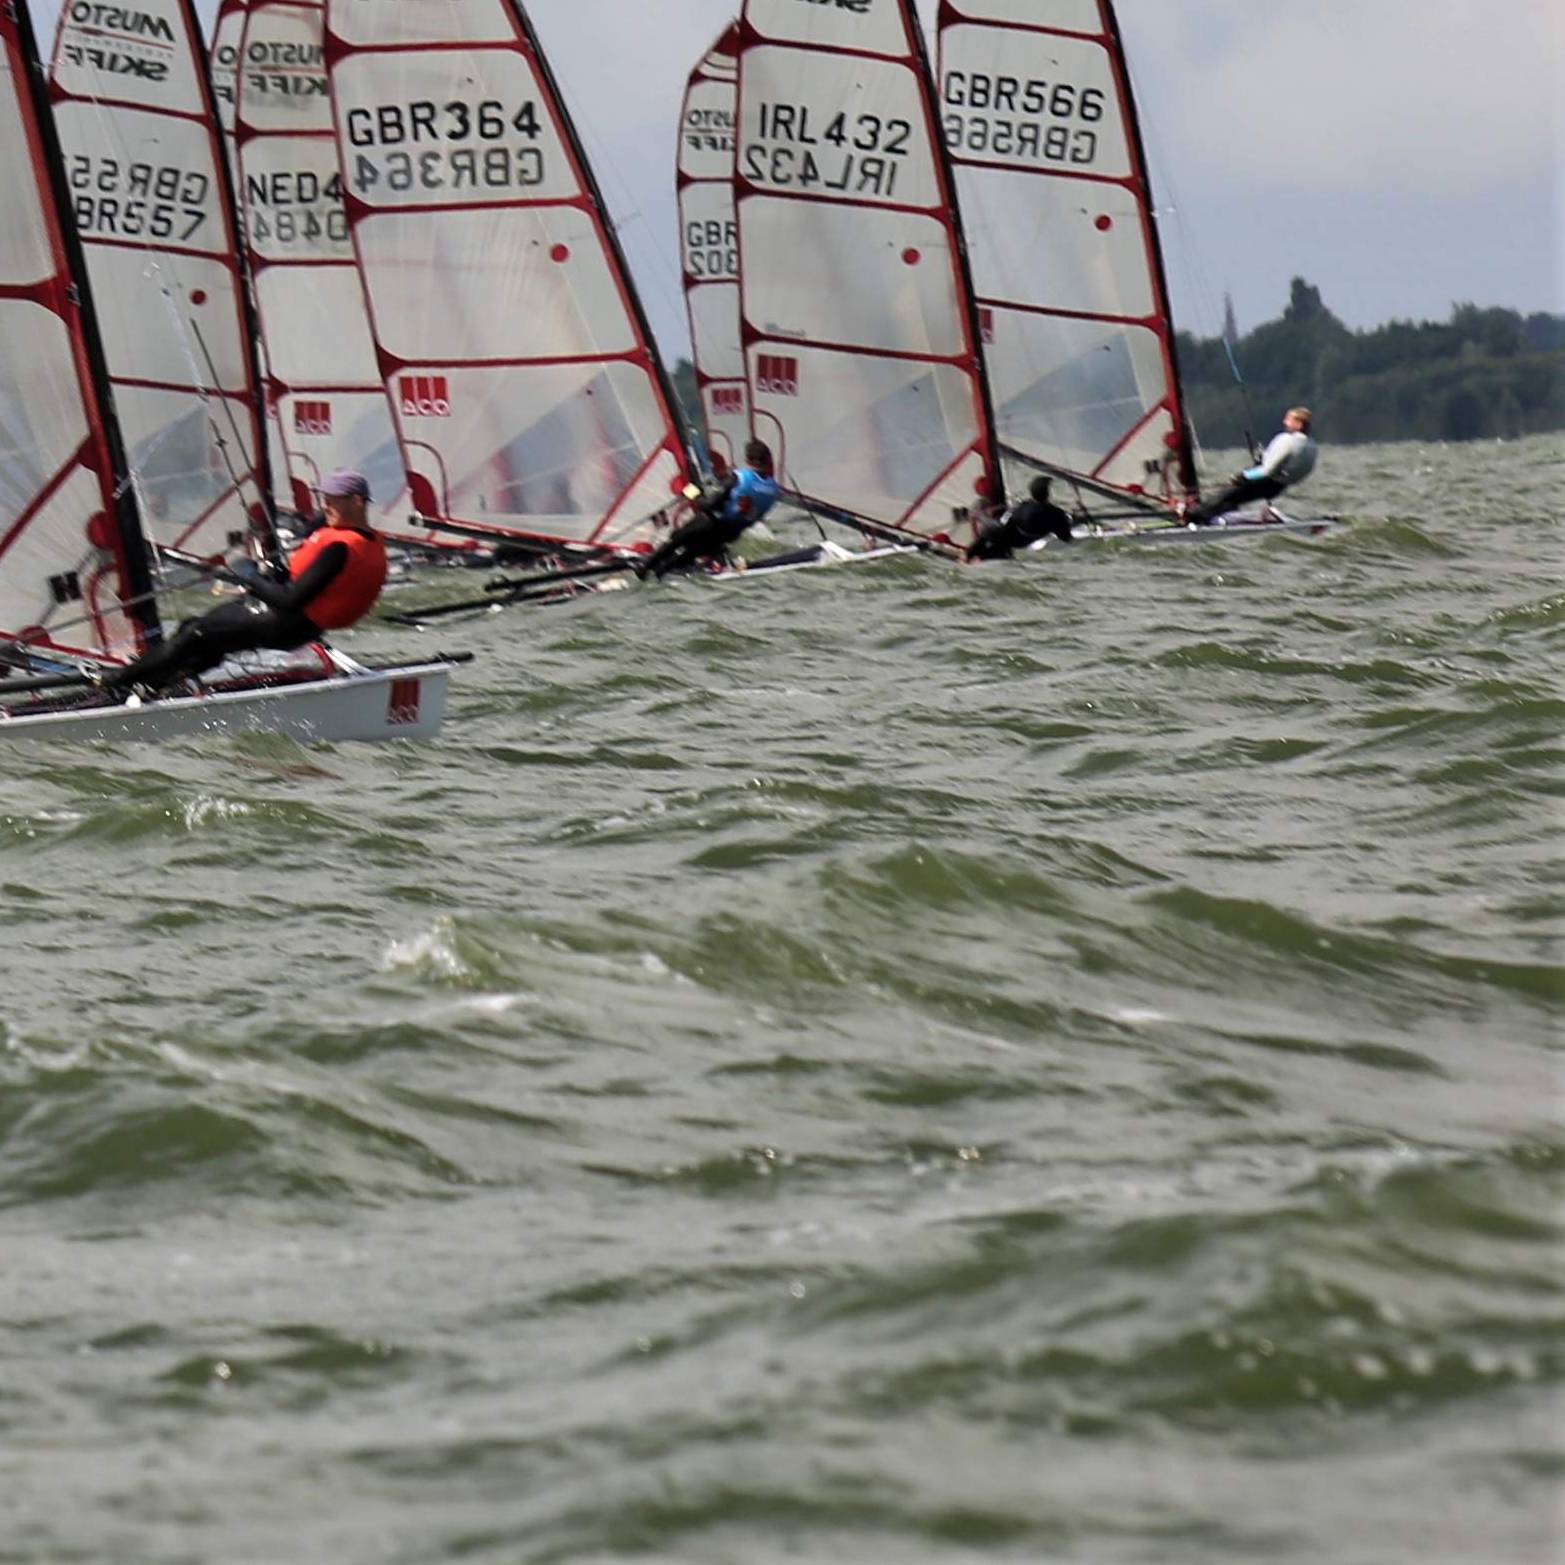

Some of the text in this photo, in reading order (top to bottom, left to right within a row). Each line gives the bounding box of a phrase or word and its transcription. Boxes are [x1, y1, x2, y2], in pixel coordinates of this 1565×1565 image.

[945, 71, 1105, 122] GBR566
[347, 100, 541, 147] GBR364
[760, 102, 911, 156] IRL432
